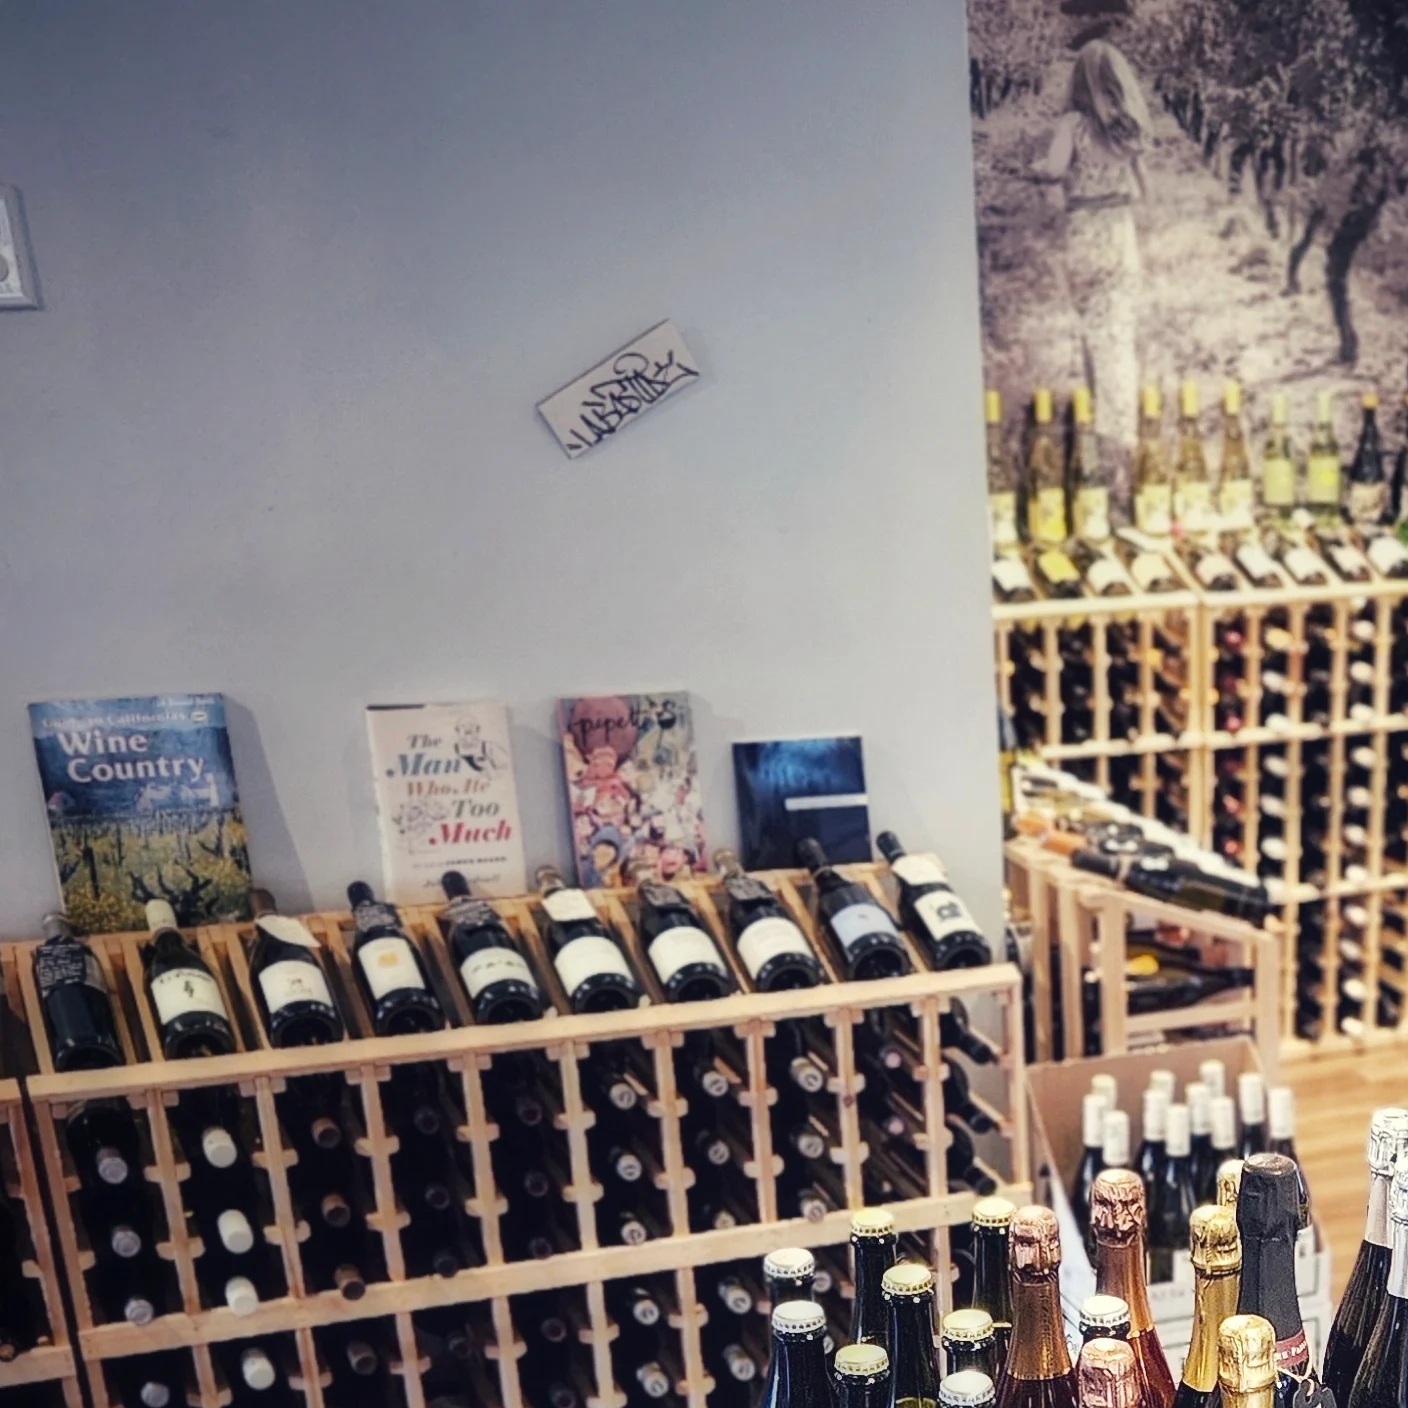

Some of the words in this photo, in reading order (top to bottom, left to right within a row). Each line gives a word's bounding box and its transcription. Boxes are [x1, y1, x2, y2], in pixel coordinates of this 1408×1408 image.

[57, 729, 149, 756] Wine
[407, 733, 442, 749] The
[67, 756, 204, 784] Country
[386, 753, 462, 777] Man
[407, 780, 451, 797] Who
[452, 799, 500, 819] Too
[429, 819, 512, 846] Much
